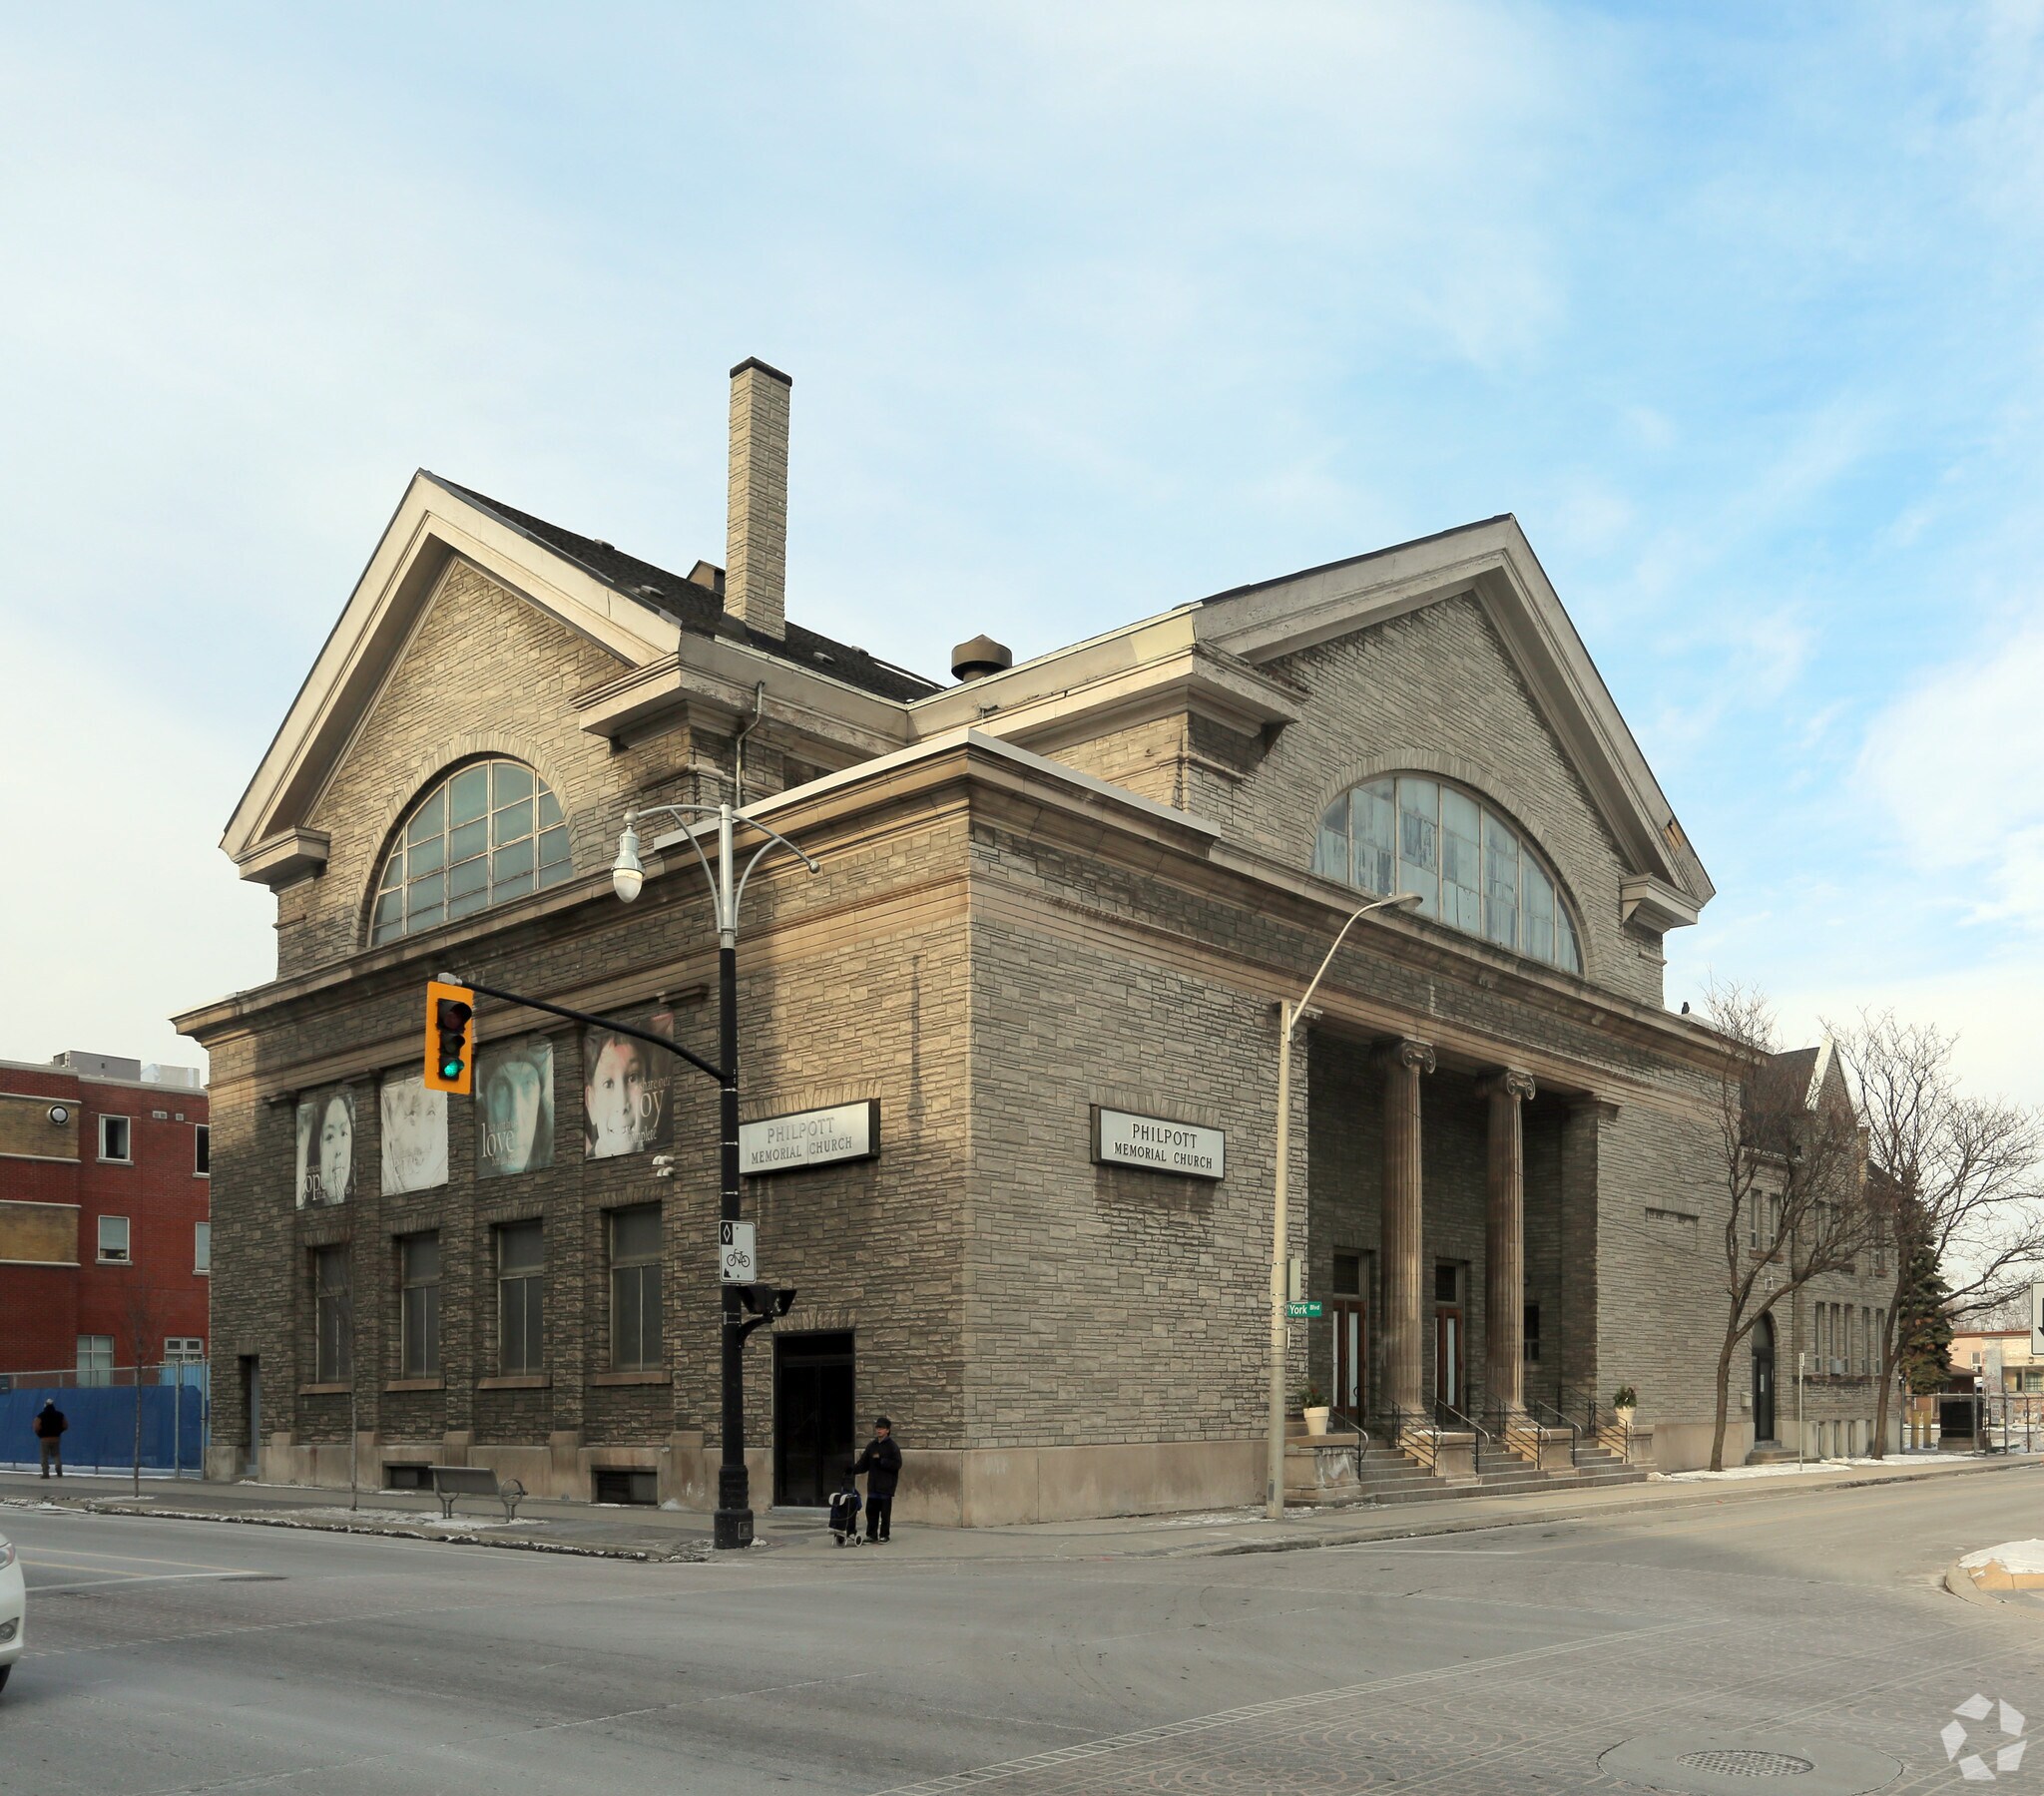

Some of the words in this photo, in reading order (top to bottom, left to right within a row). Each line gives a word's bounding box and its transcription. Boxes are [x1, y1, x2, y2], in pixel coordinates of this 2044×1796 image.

[637, 1089, 665, 1128] oy
[481, 1122, 515, 1157] love
[767, 1117, 835, 1143] PHILPOTT
[1132, 1122, 1198, 1148] PHILPOTT
[751, 1144, 802, 1164] MEMORIAL
[809, 1135, 852, 1154] CHURCH
[1113, 1141, 1167, 1162] MEMORIAL
[1173, 1151, 1213, 1169] CHURCH
[1289, 1304, 1307, 1315] York
